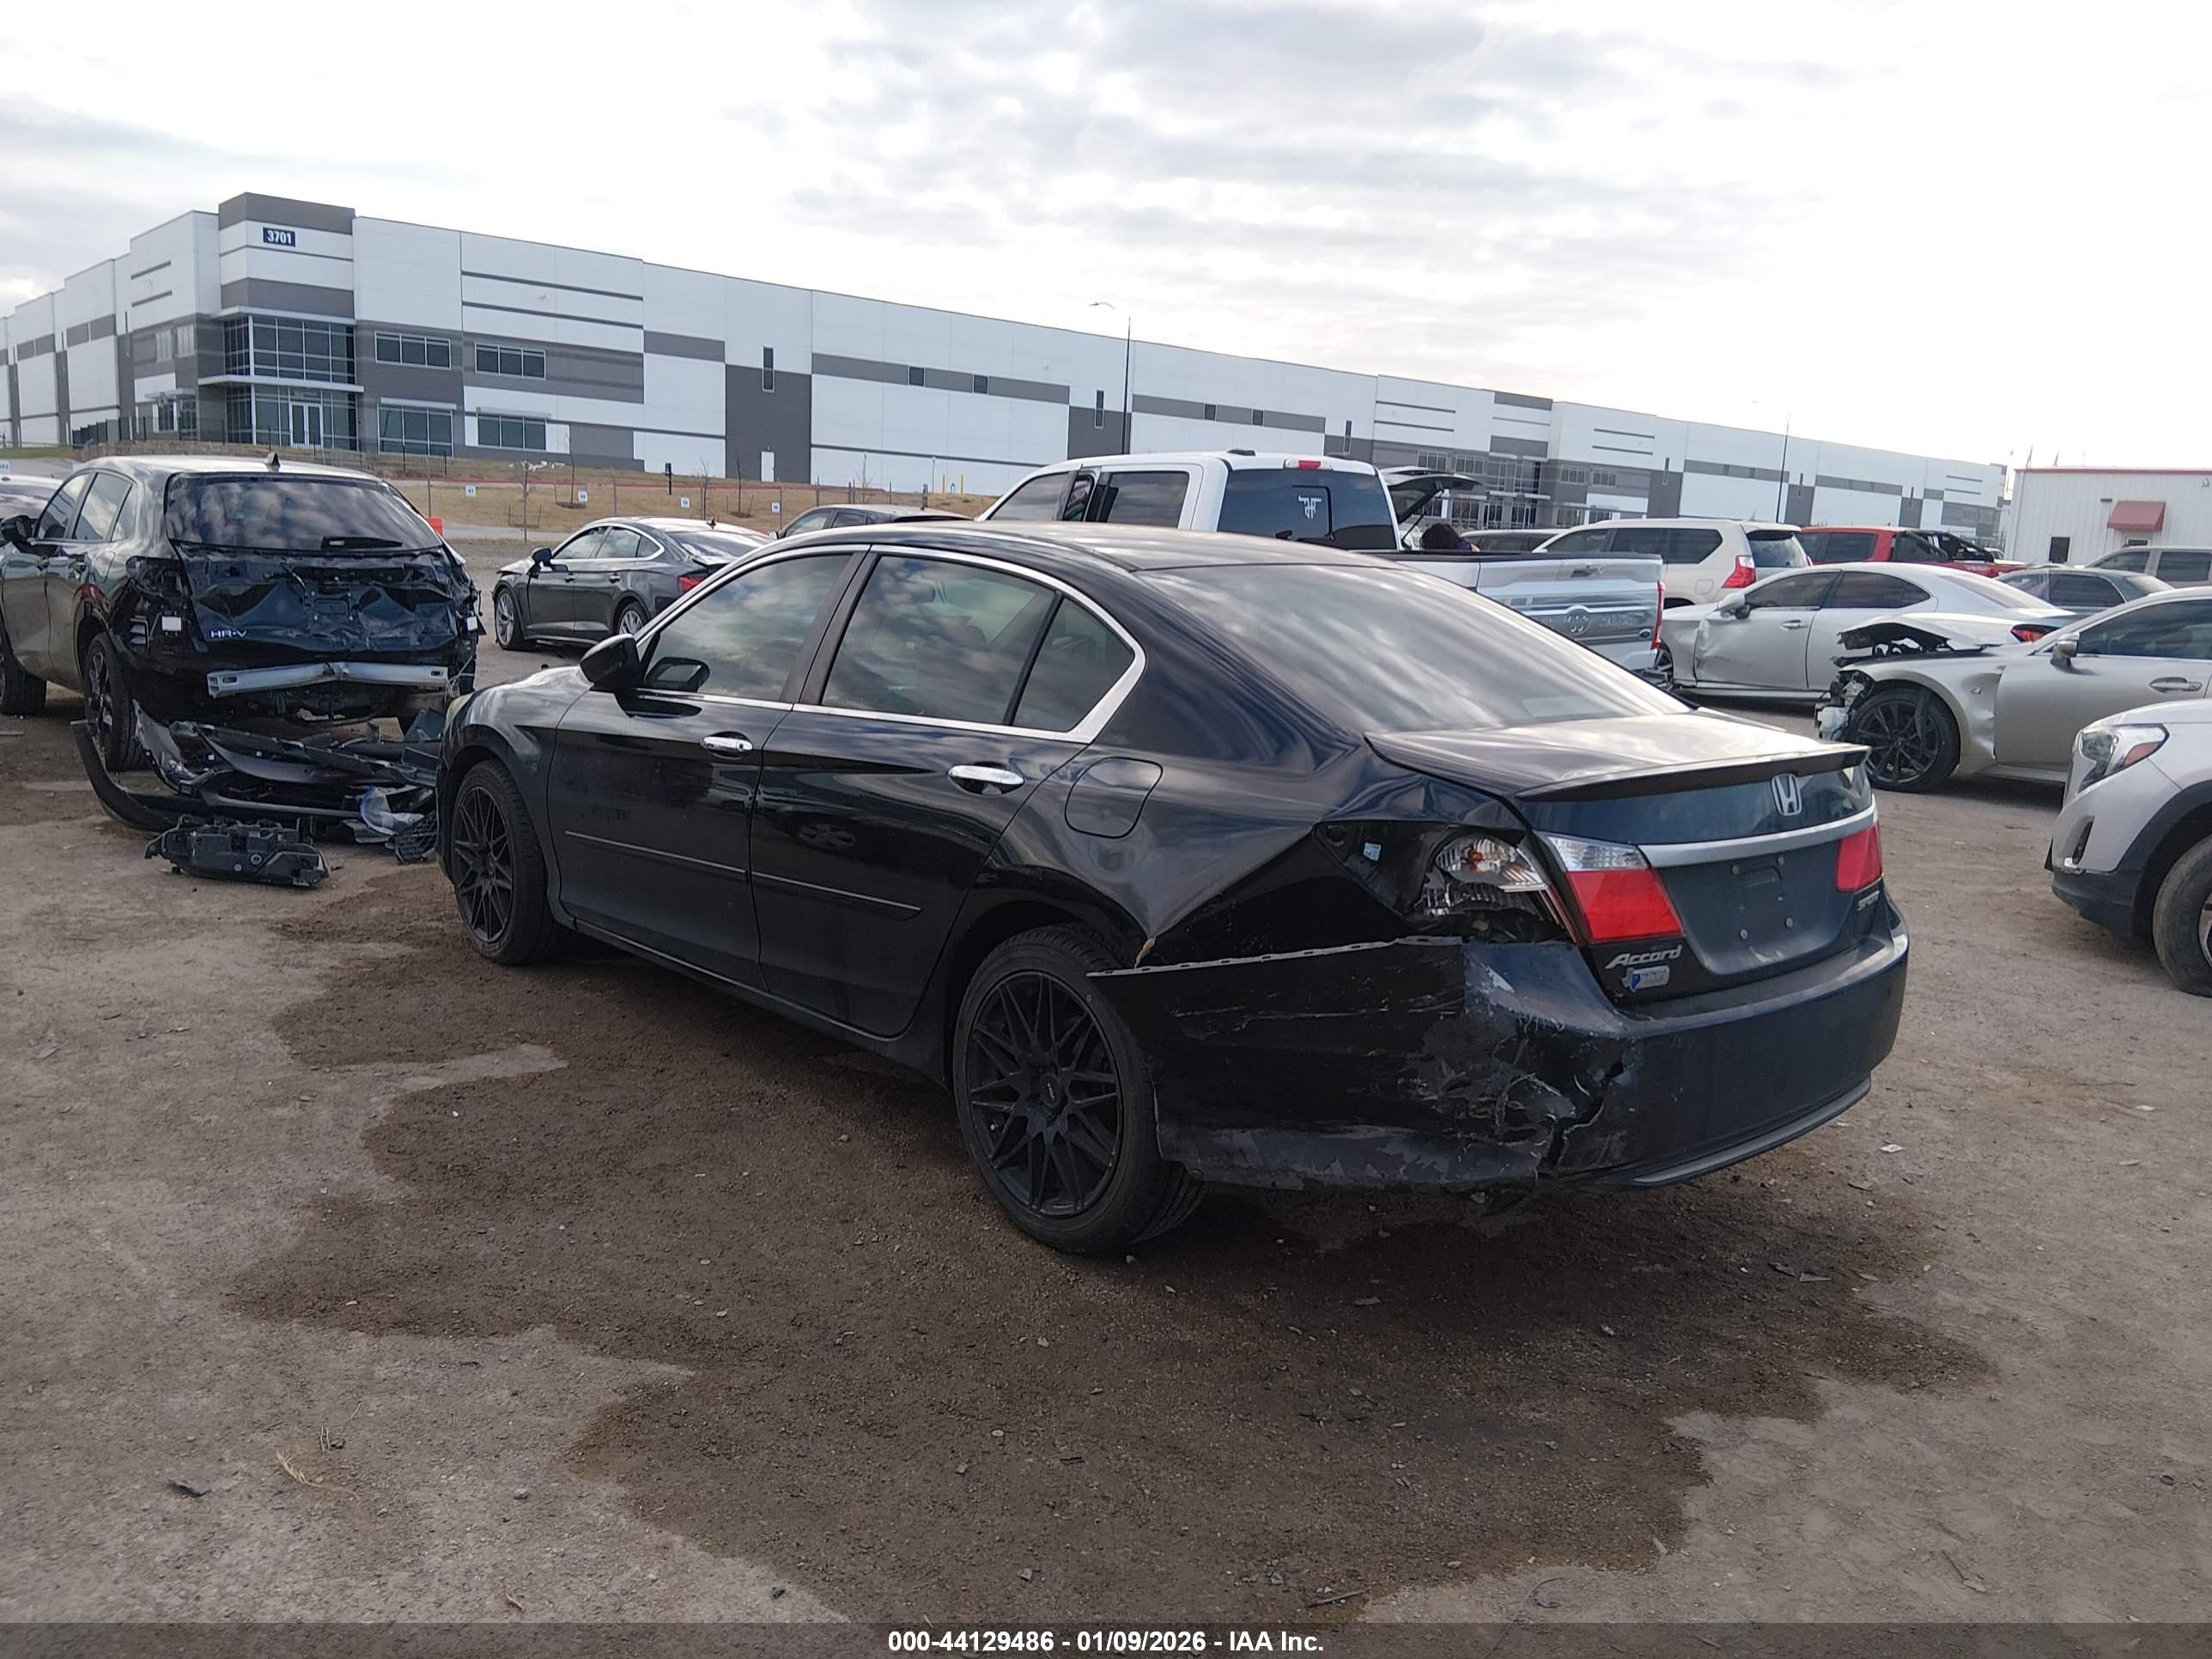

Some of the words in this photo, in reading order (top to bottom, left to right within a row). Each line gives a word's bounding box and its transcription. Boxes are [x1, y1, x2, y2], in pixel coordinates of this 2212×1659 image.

[267, 229, 292, 245] 3701
[210, 629, 247, 638] HR-V
[1604, 945, 1682, 969] Accord
